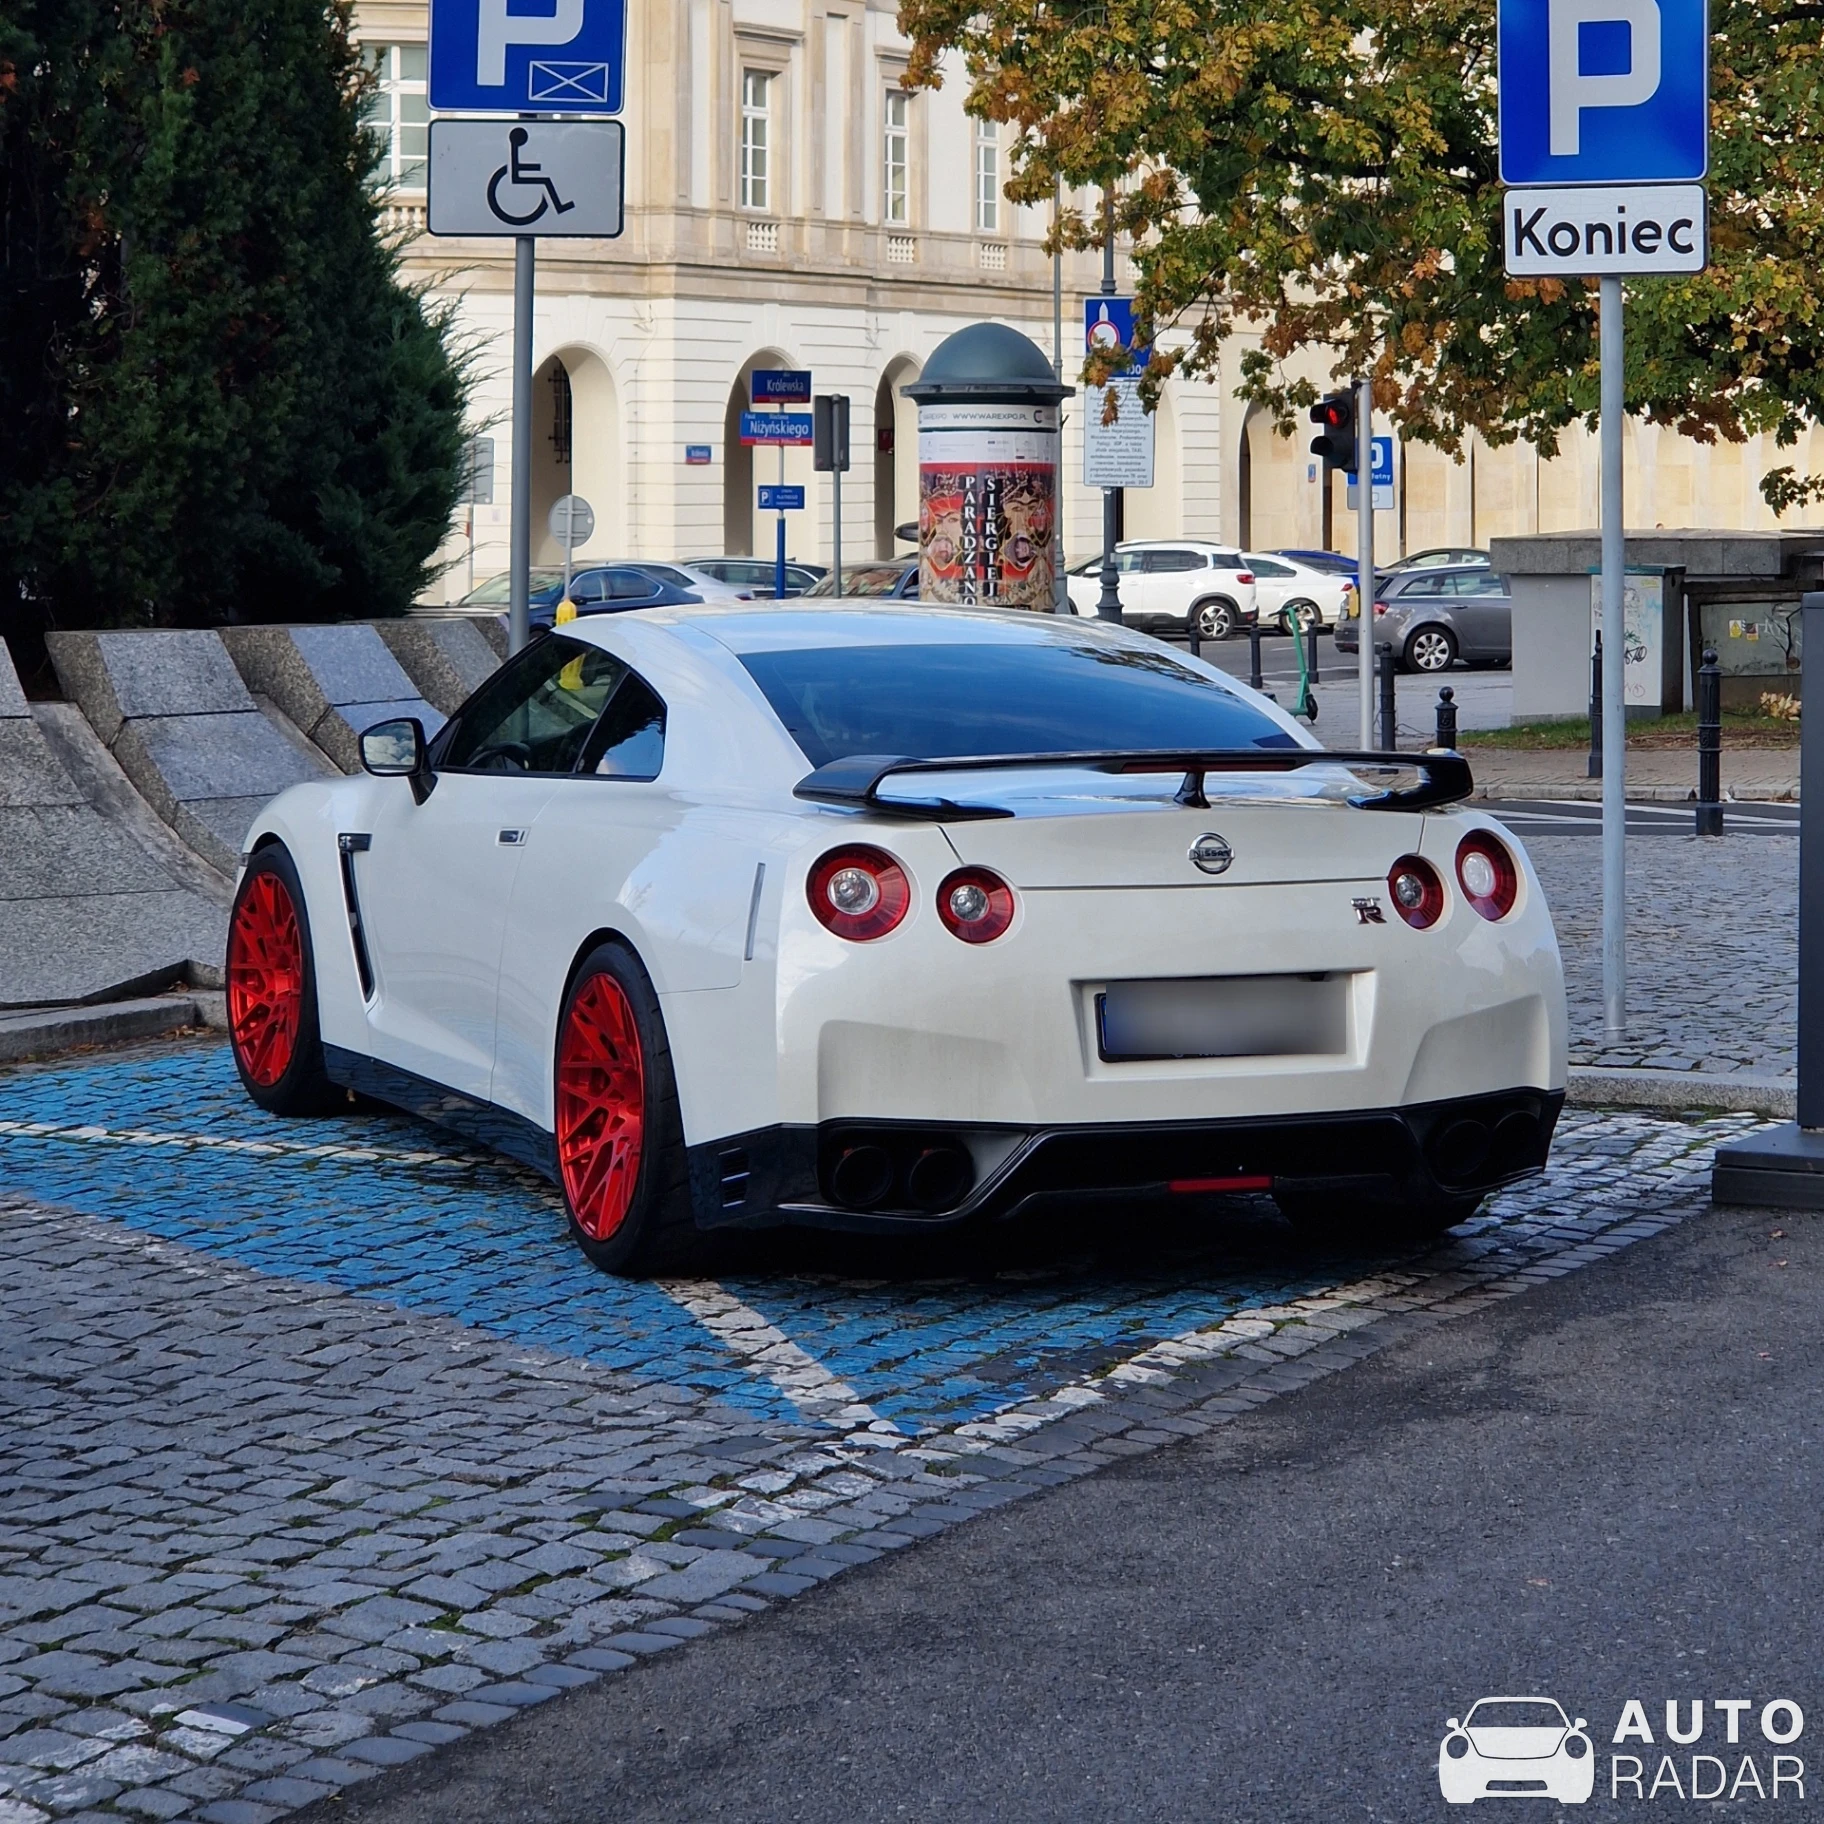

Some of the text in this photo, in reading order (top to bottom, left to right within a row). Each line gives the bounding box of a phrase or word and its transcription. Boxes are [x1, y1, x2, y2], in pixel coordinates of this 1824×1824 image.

[1548, 0, 1661, 156] P
[1513, 205, 1694, 257] Koniec
[766, 379, 804, 392] Królewska
[750, 421, 809, 438] Niżyńskiego
[761, 491, 769, 503] P
[985, 478, 998, 597] SIERGIEJ
[1192, 849, 1231, 858] NISSAN
